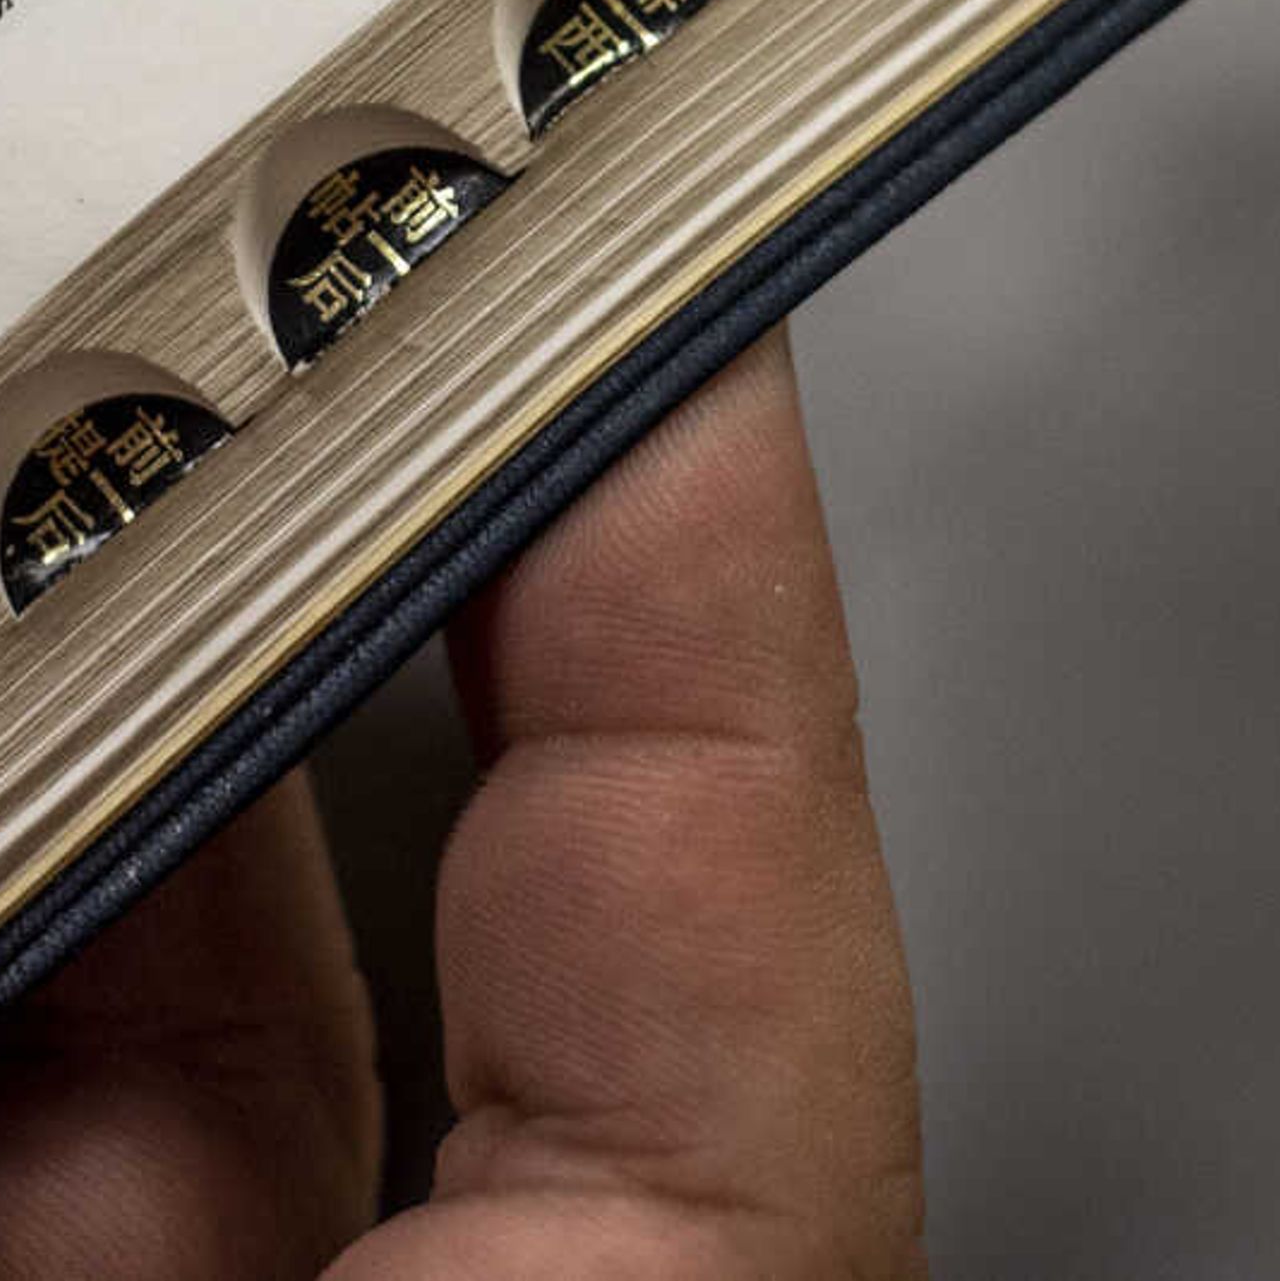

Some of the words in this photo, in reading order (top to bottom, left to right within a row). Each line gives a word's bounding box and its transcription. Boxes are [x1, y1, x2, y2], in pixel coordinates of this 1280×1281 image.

[546, 2, 633, 89] 西
[308, 172, 382, 241] 帖
[386, 167, 462, 244] 前
[290, 243, 374, 322] 后
[108, 405, 183, 485] 前
[15, 493, 96, 566] 后
